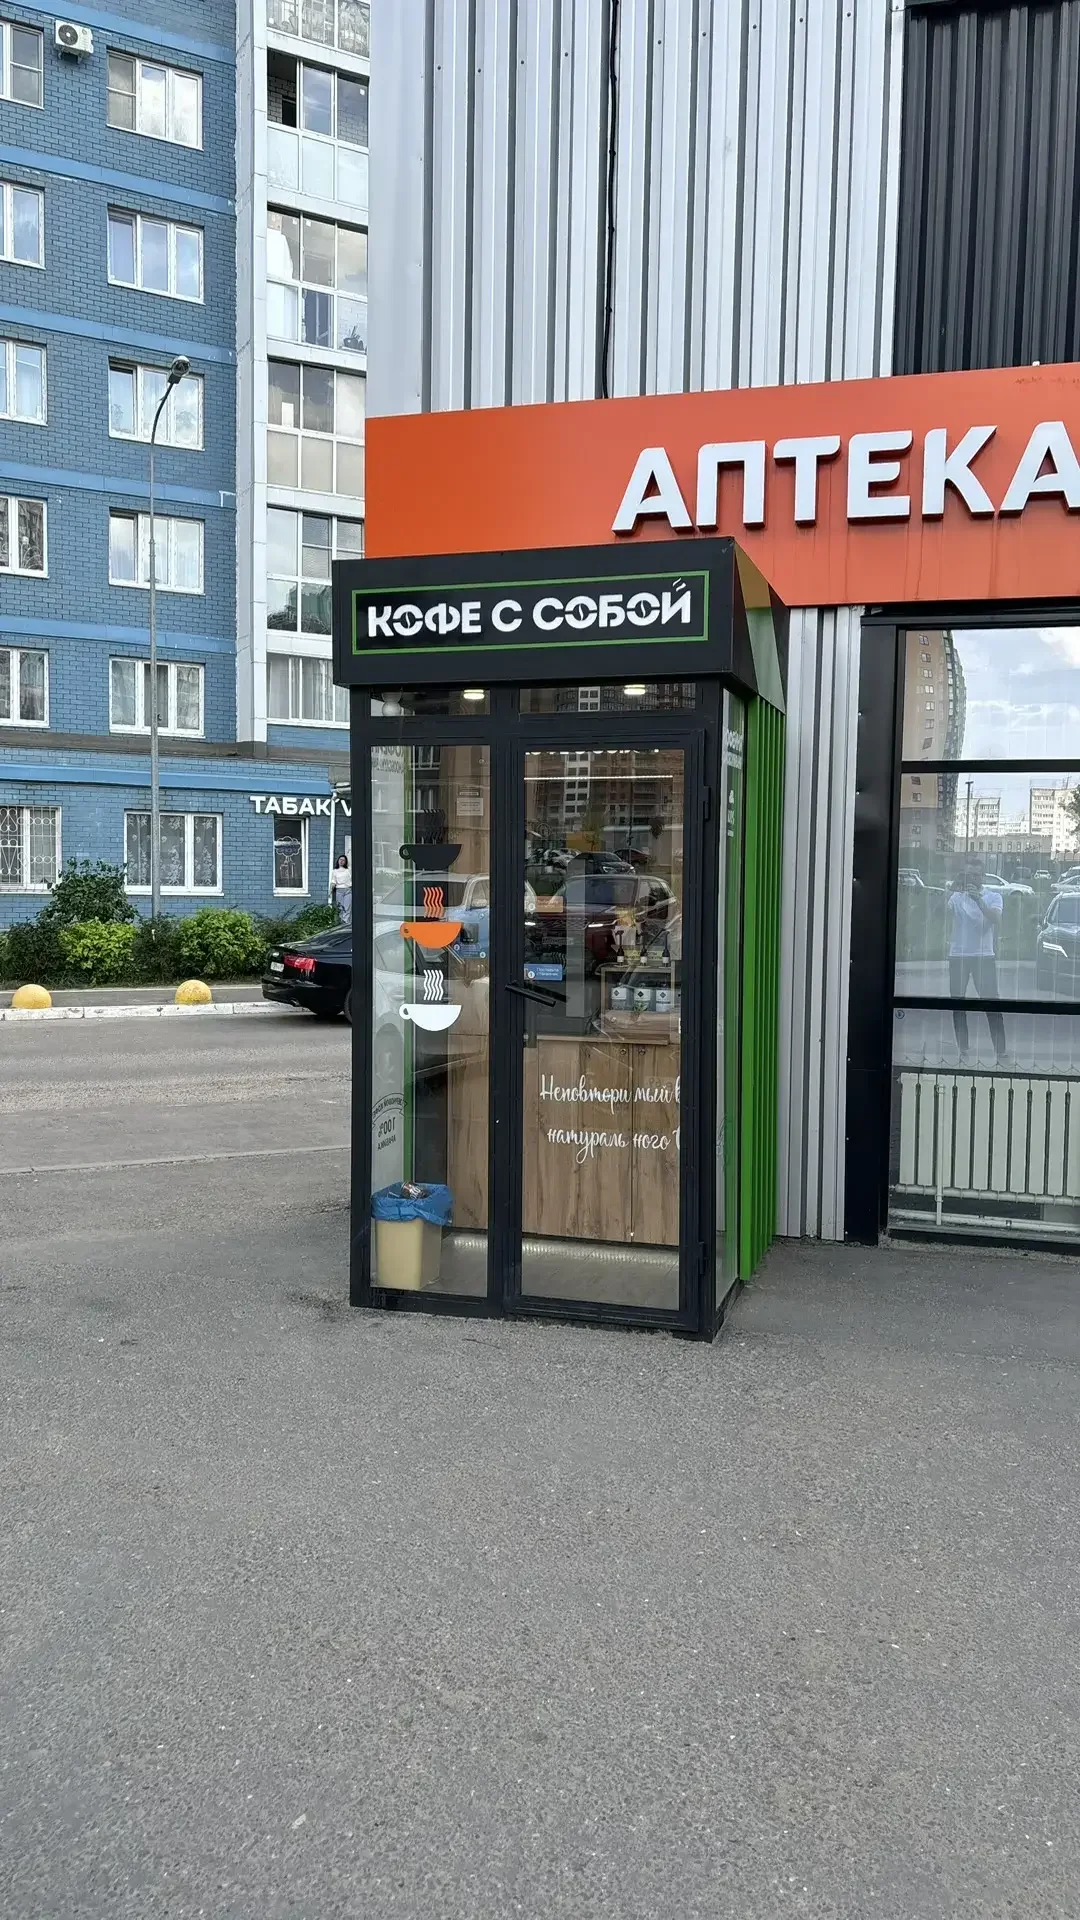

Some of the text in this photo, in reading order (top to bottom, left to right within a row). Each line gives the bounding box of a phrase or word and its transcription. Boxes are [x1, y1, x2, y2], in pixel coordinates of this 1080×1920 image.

[611, 421, 1080, 534] АПТЕКА
[367, 578, 691, 637] КОФЕ С СОБОЙ
